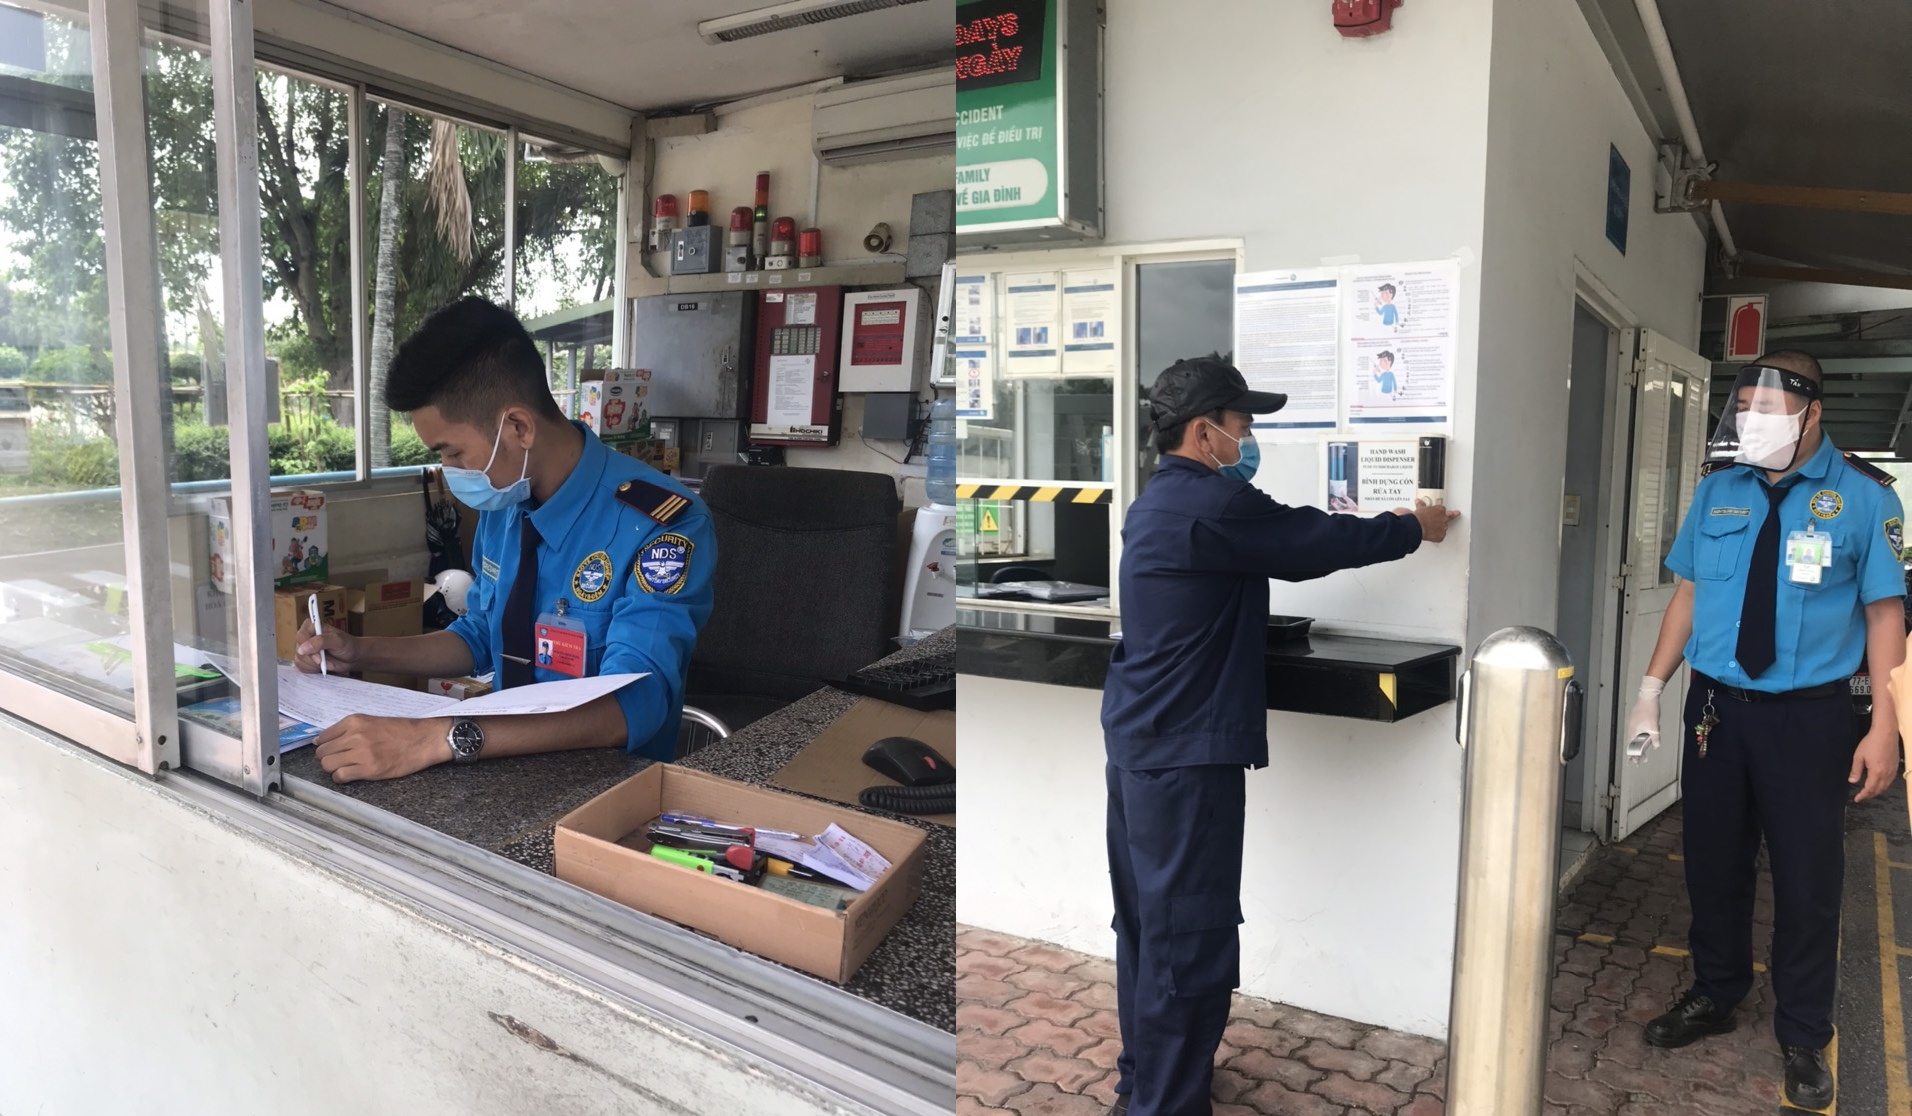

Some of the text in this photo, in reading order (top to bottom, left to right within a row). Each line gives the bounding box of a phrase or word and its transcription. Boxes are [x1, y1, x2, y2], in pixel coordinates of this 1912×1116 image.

[971, 189, 991, 204] GIA
[993, 185, 1021, 203] ĐÌNH
[651, 547, 677, 560] NDS
